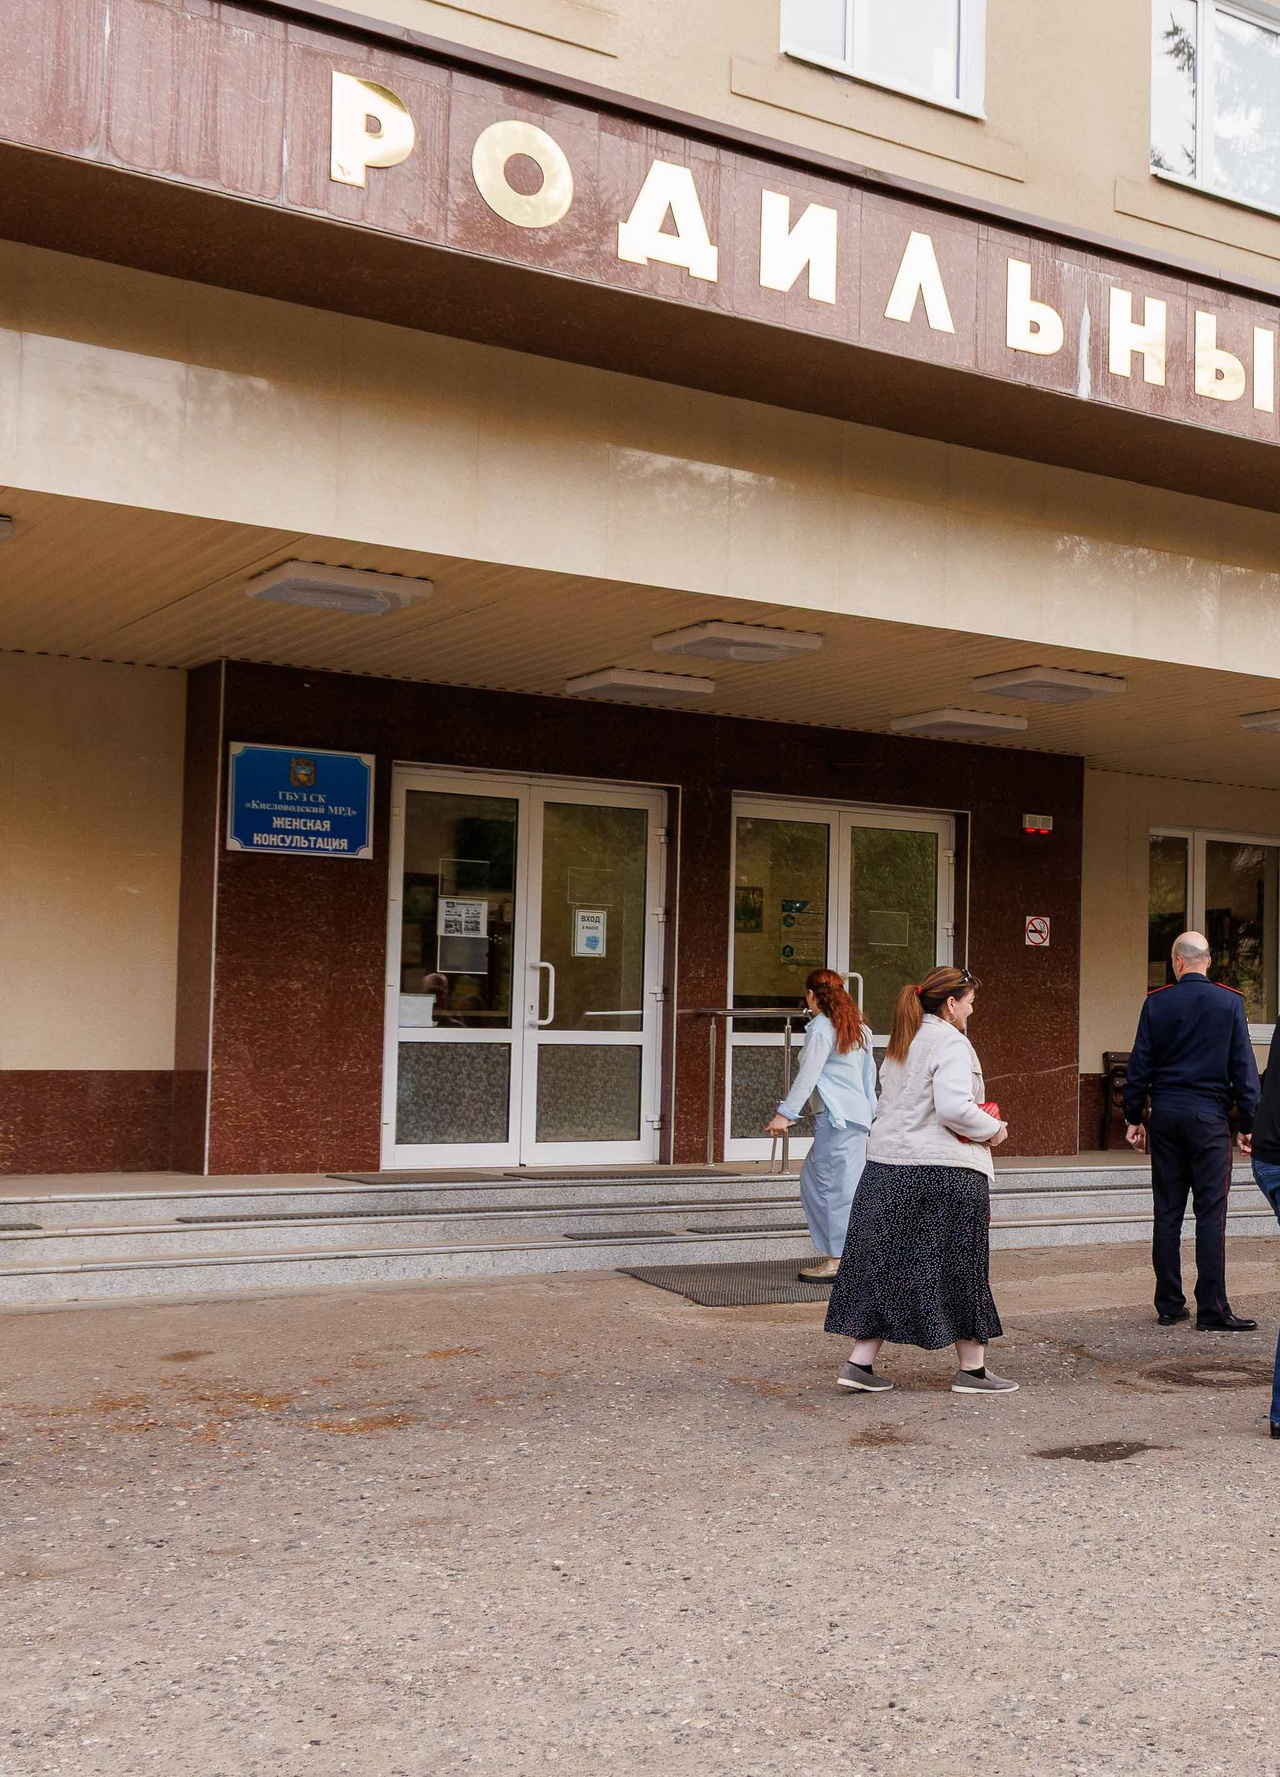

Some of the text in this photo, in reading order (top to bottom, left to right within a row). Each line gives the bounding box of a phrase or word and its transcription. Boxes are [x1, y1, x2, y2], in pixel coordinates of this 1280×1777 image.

[278, 791, 326, 803] ГБУЗ СК
[245, 799, 357, 816] «Кисловодский МРД»
[272, 816, 330, 831] ЖЕНСКАЯ
[253, 832, 348, 850] КОНСУЛЬТАЦИЯ
[581, 915, 600, 924] ВХОД
